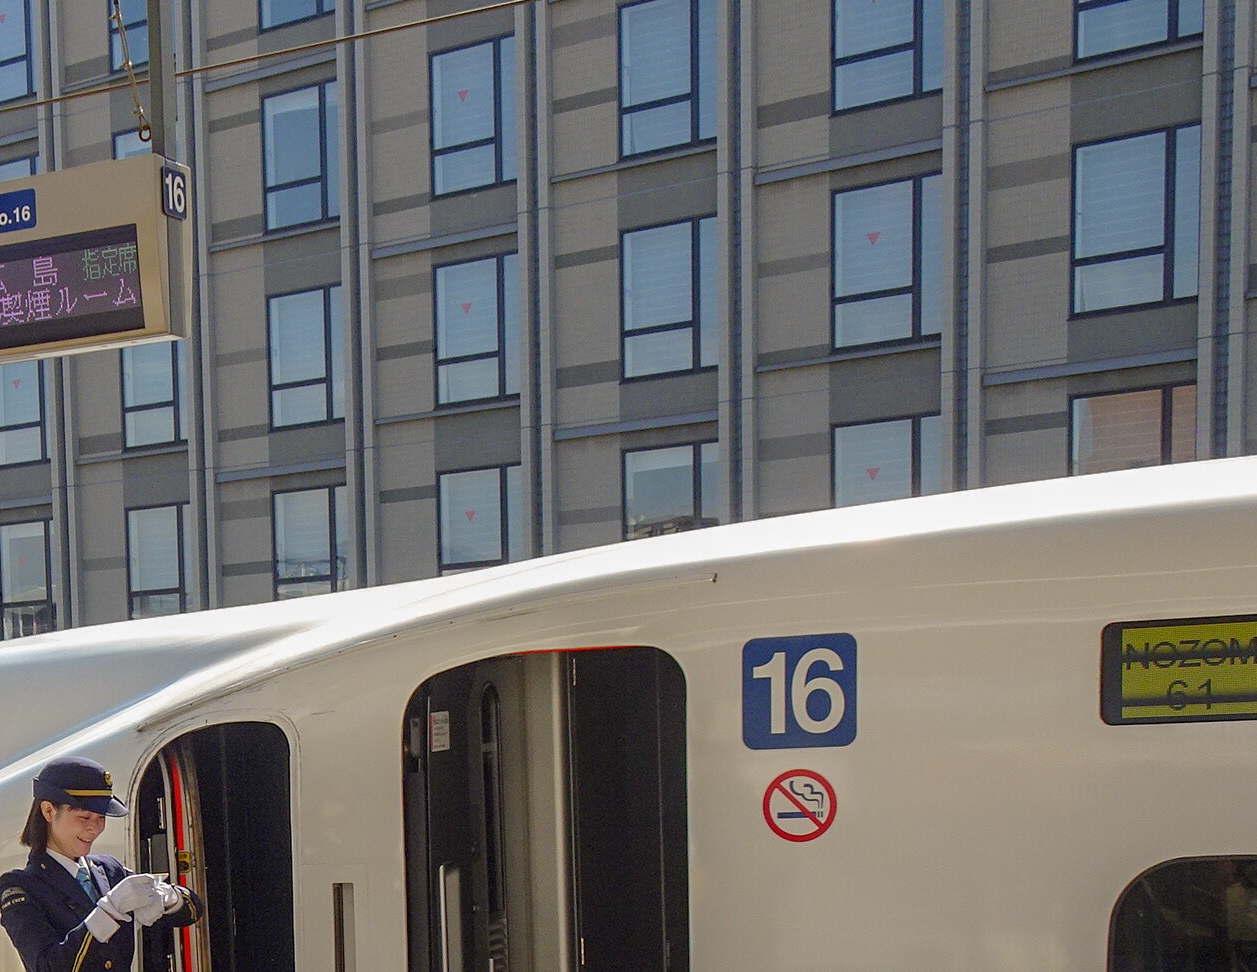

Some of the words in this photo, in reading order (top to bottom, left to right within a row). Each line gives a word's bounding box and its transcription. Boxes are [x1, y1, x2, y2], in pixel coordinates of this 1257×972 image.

[165, 173, 185, 213] 16
[82, 243, 137, 281] 指定席
[752, 647, 846, 734] 16
[1166, 679, 1212, 711] 61
